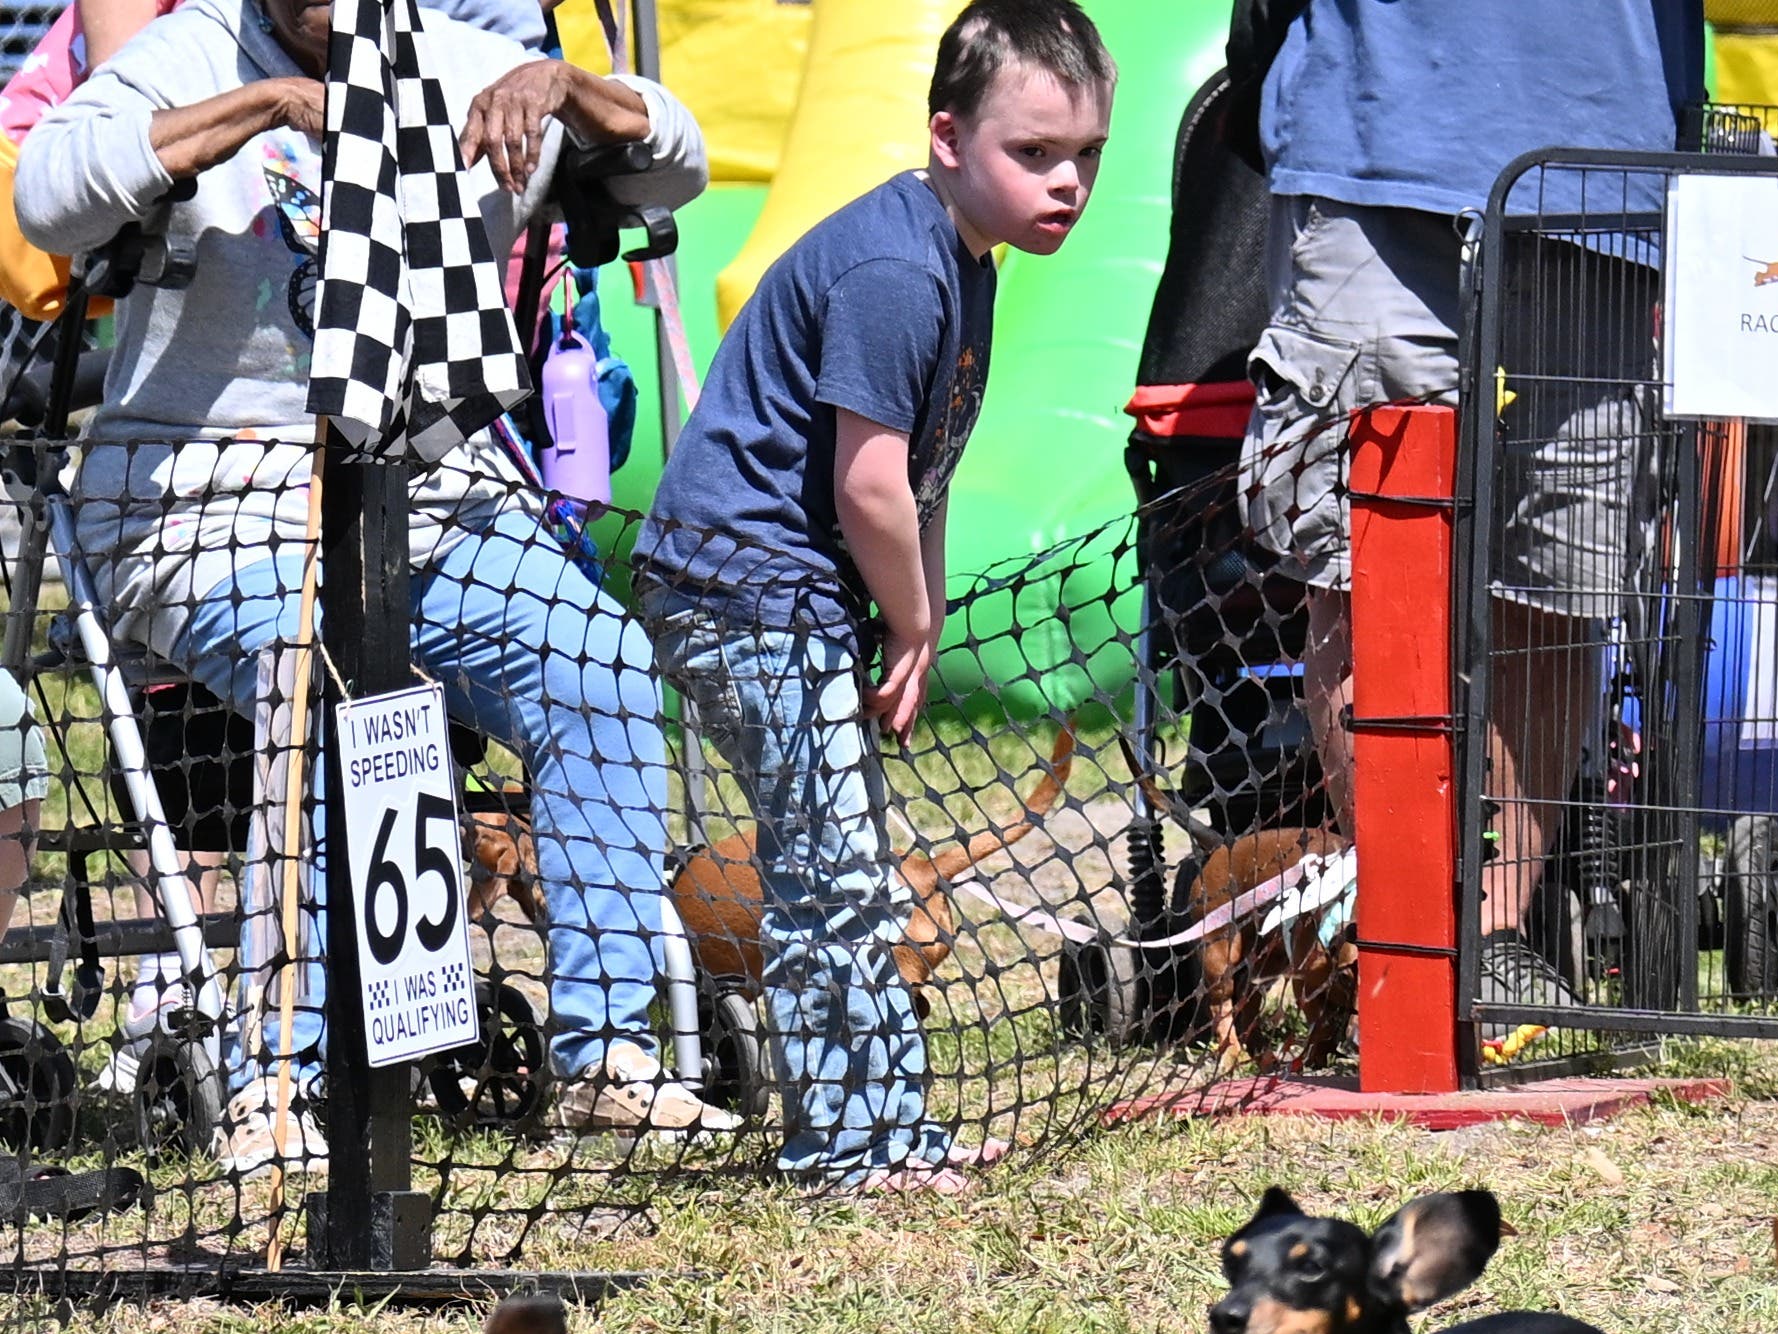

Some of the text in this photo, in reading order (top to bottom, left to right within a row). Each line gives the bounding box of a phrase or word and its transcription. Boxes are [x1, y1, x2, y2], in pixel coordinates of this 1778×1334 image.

[351, 705, 431, 749] I WASN'T
[350, 743, 439, 788] SPEEDING
[364, 791, 459, 966] 65
[394, 970, 437, 1005] I WAS
[372, 997, 469, 1045] QUALIFYING
